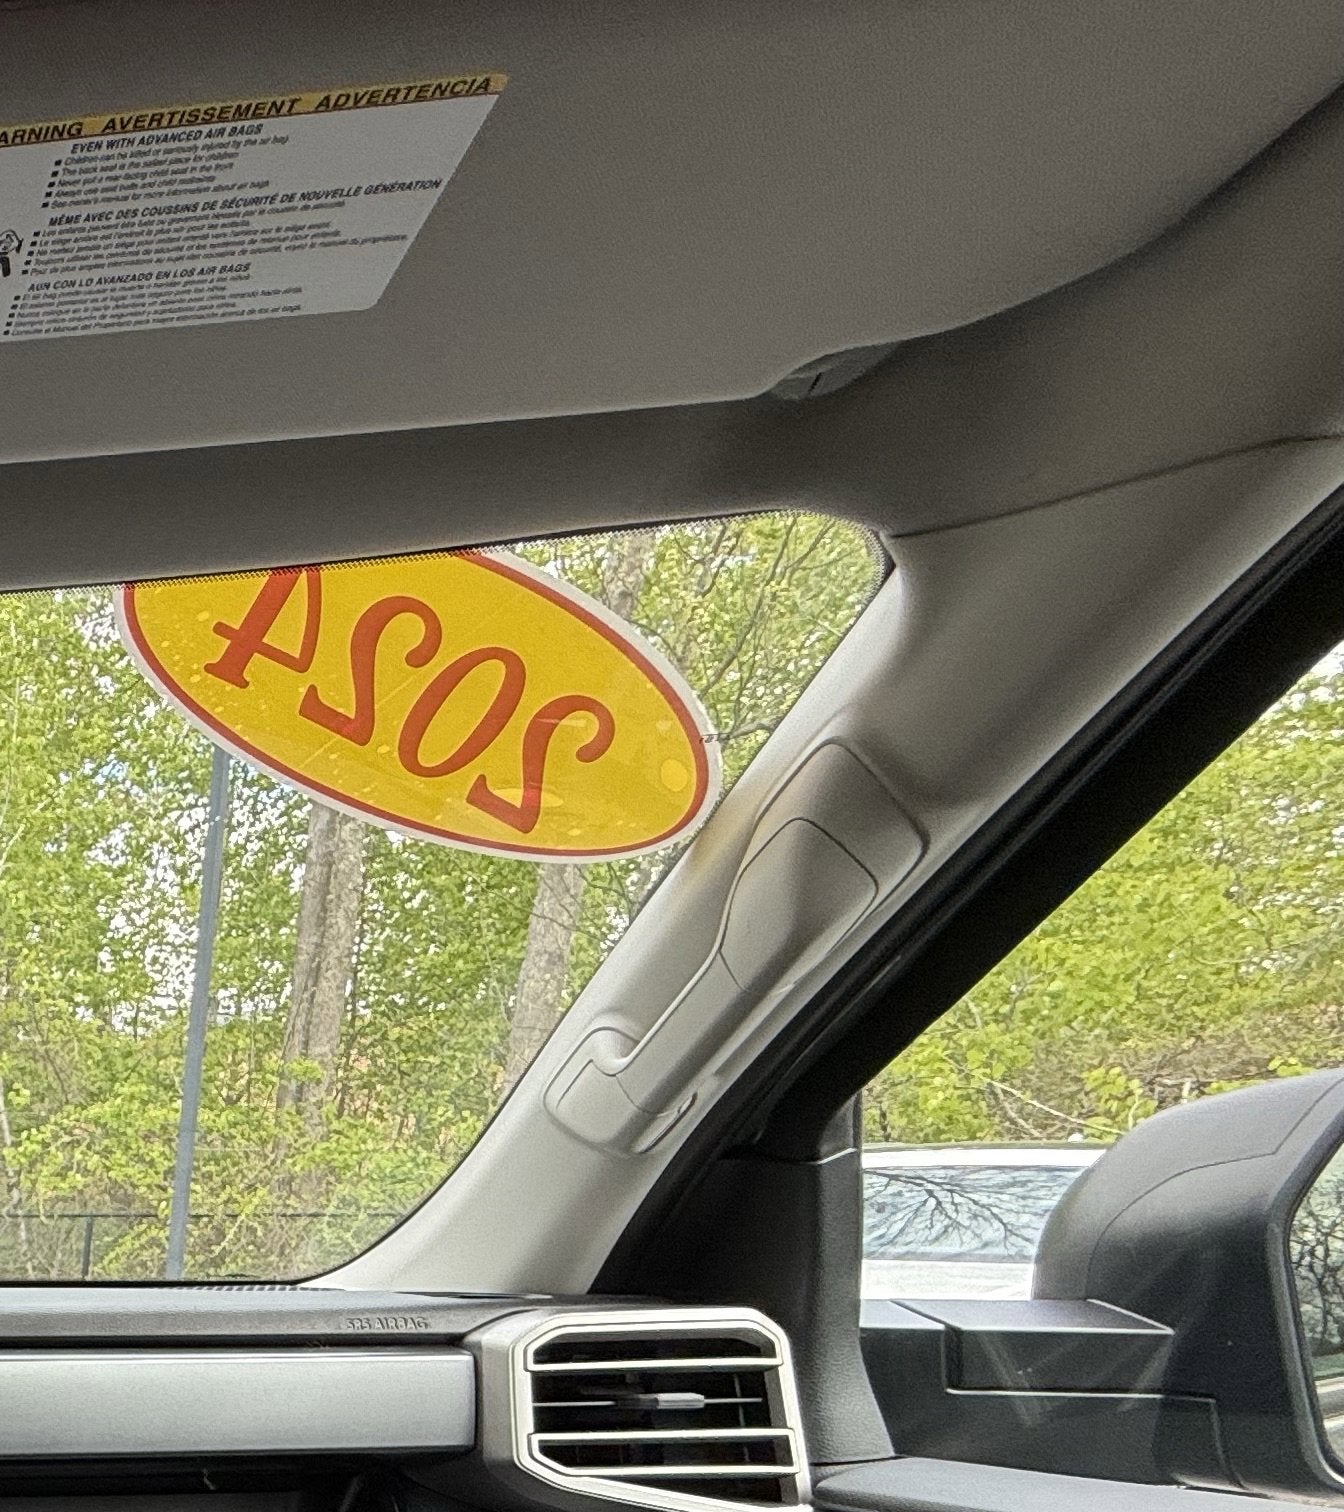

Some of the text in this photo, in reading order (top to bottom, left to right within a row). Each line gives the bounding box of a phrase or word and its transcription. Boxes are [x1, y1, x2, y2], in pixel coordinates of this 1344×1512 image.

[101, 97, 304, 133] AVERTISSEMENT
[314, 77, 491, 111] ADVERTENCIA
[71, 141, 103, 154] EVEN
[106, 137, 135, 150] WITH
[204, 127, 225, 139] AIR
[374, 1316, 428, 1331] AIRBAG
